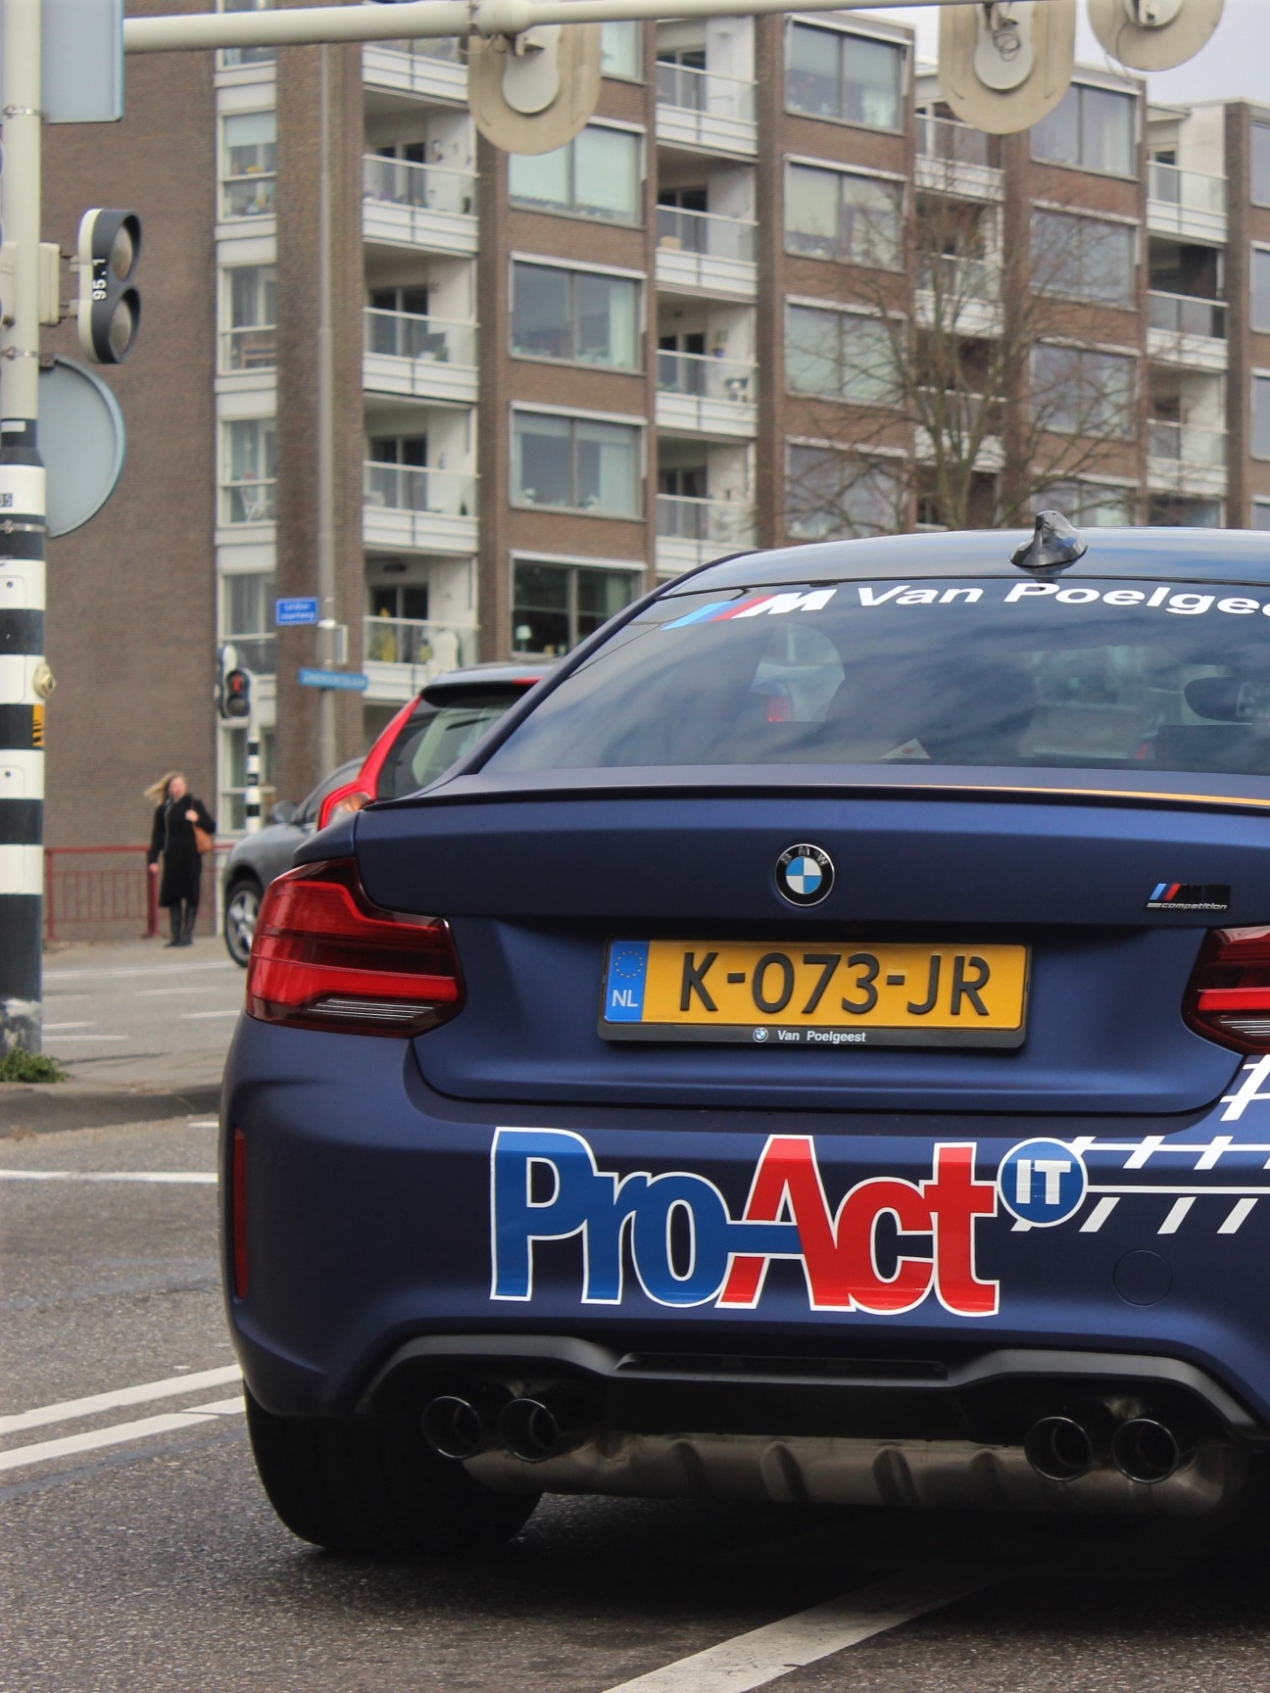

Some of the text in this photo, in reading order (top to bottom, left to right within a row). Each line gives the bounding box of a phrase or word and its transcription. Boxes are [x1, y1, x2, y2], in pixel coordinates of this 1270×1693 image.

[858, 584, 986, 608] Van
[781, 846, 829, 867] BMW
[1160, 902, 1228, 910] competition
[679, 950, 991, 1017] K-073-JR
[612, 989, 638, 1008] NL
[777, 1030, 867, 1045] Van Poelgeest
[1016, 1159, 1071, 1205] IT
